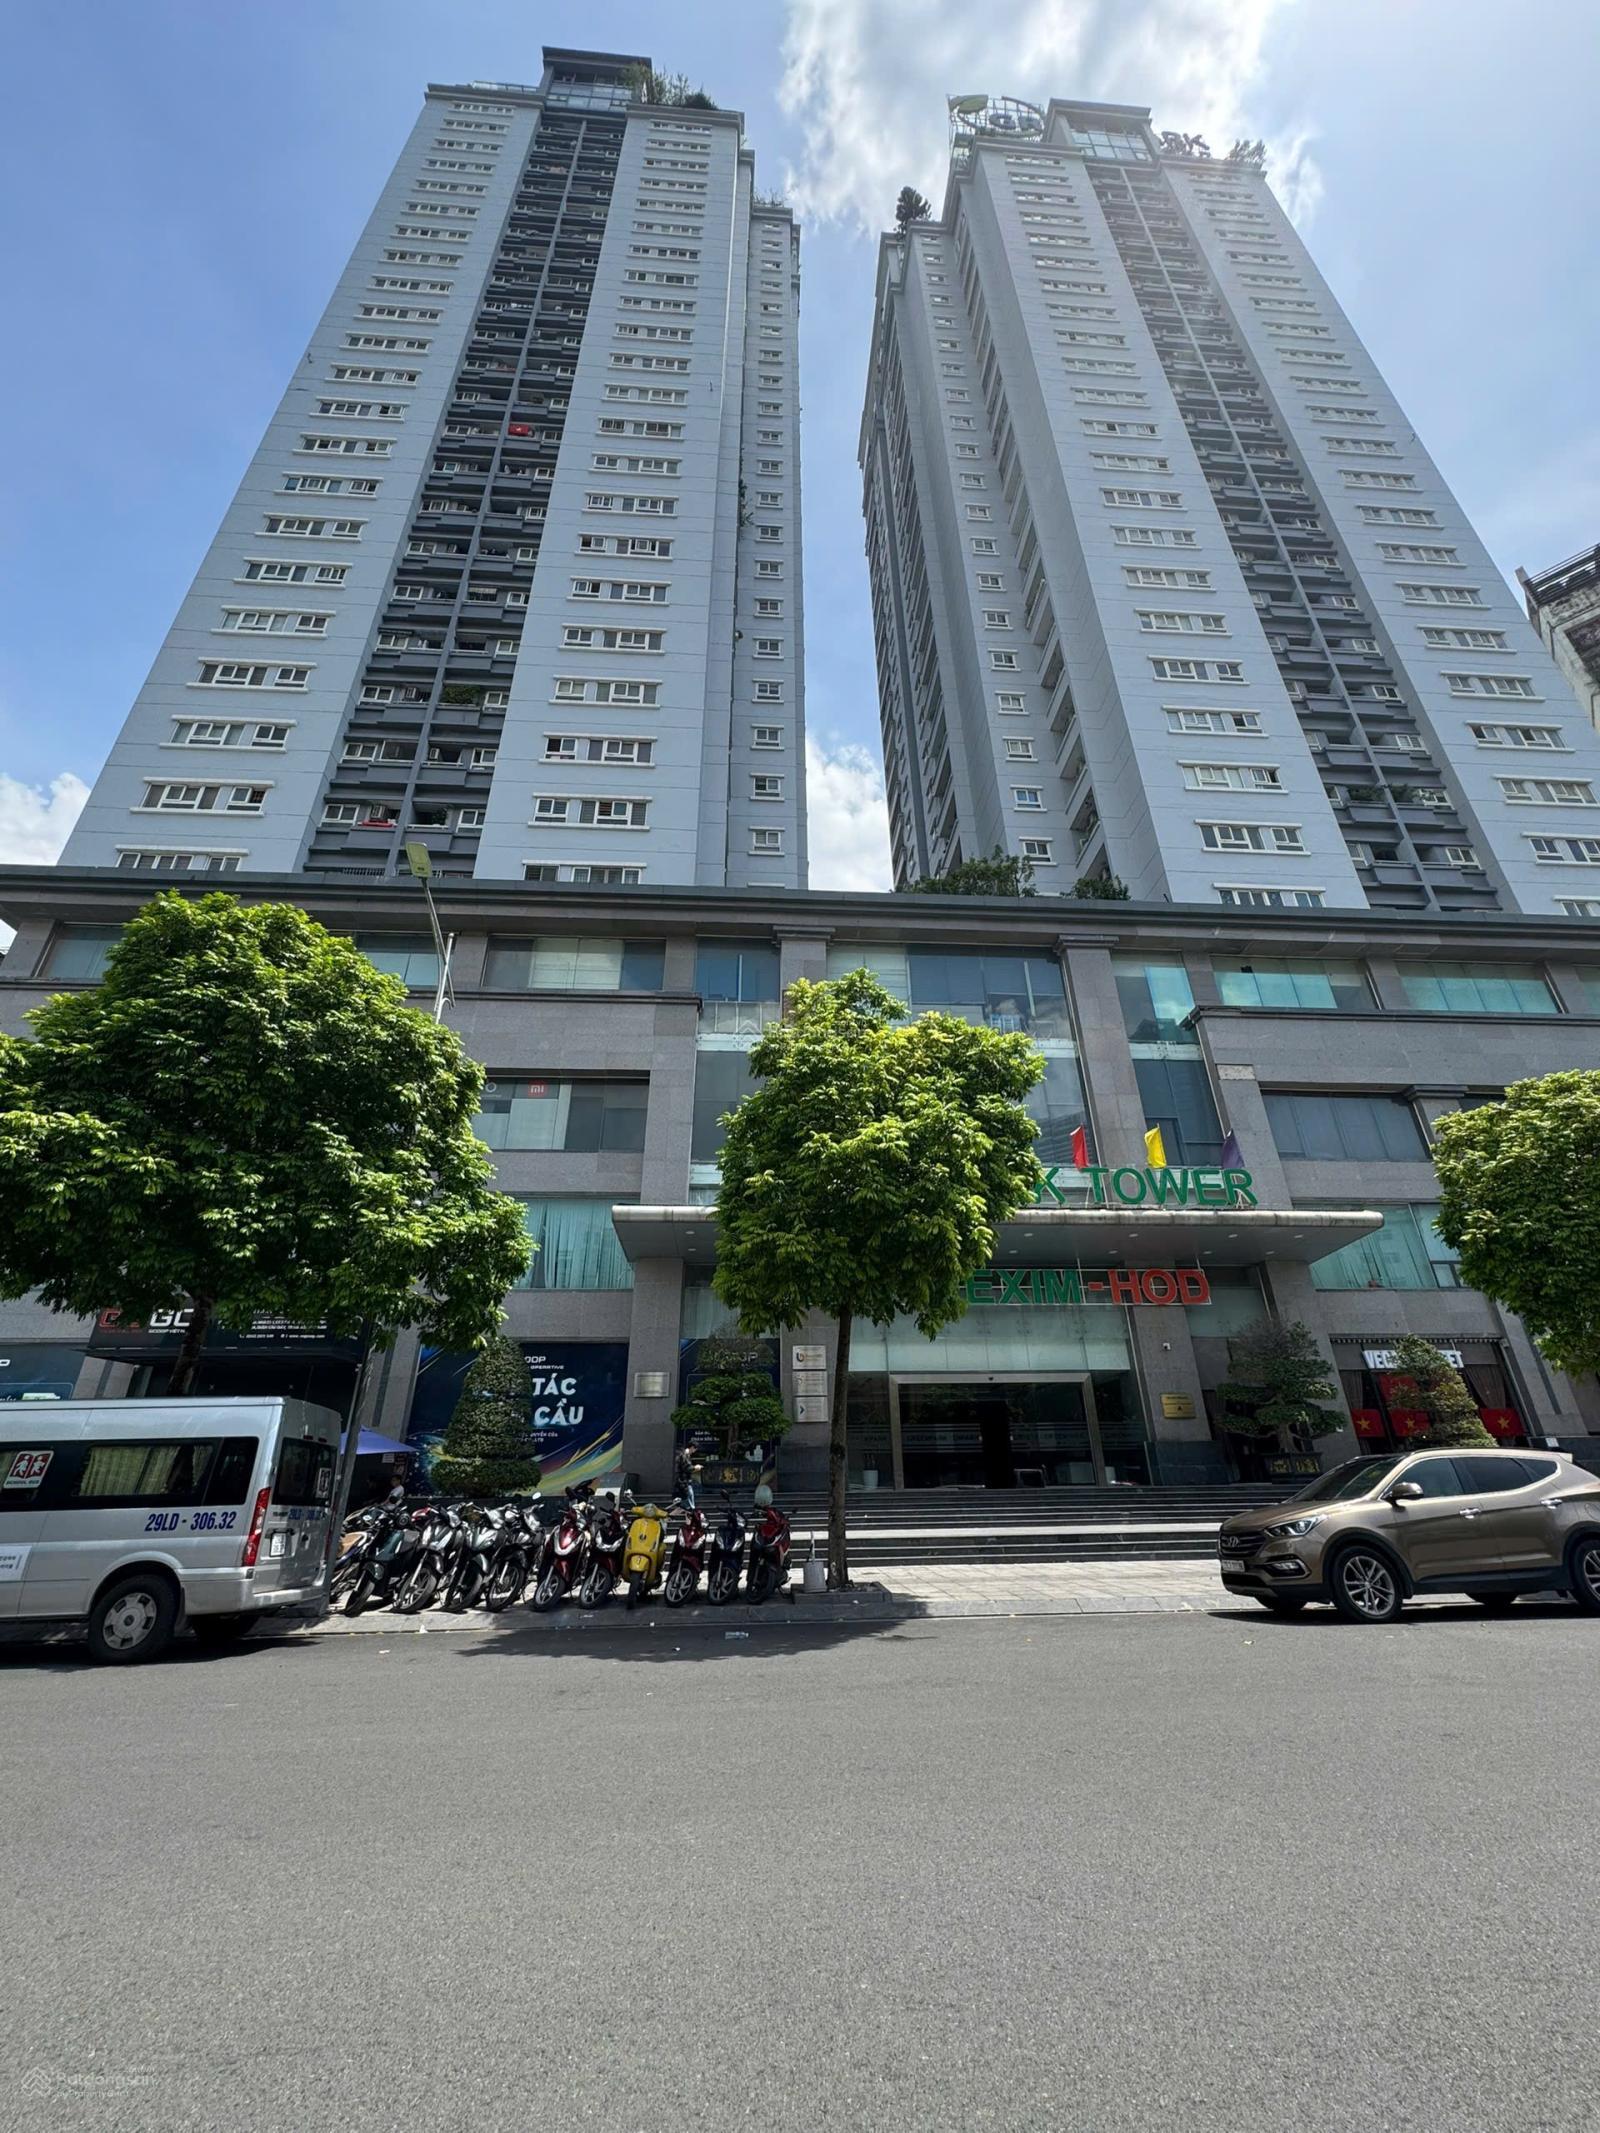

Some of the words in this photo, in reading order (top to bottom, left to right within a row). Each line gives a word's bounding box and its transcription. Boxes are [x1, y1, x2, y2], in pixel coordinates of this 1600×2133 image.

[1081, 1167, 1259, 1206] TOWER
[532, 1373, 577, 1396] TÁC
[144, 1513, 180, 1532] 29LD
[190, 1511, 237, 1530] 306.32
